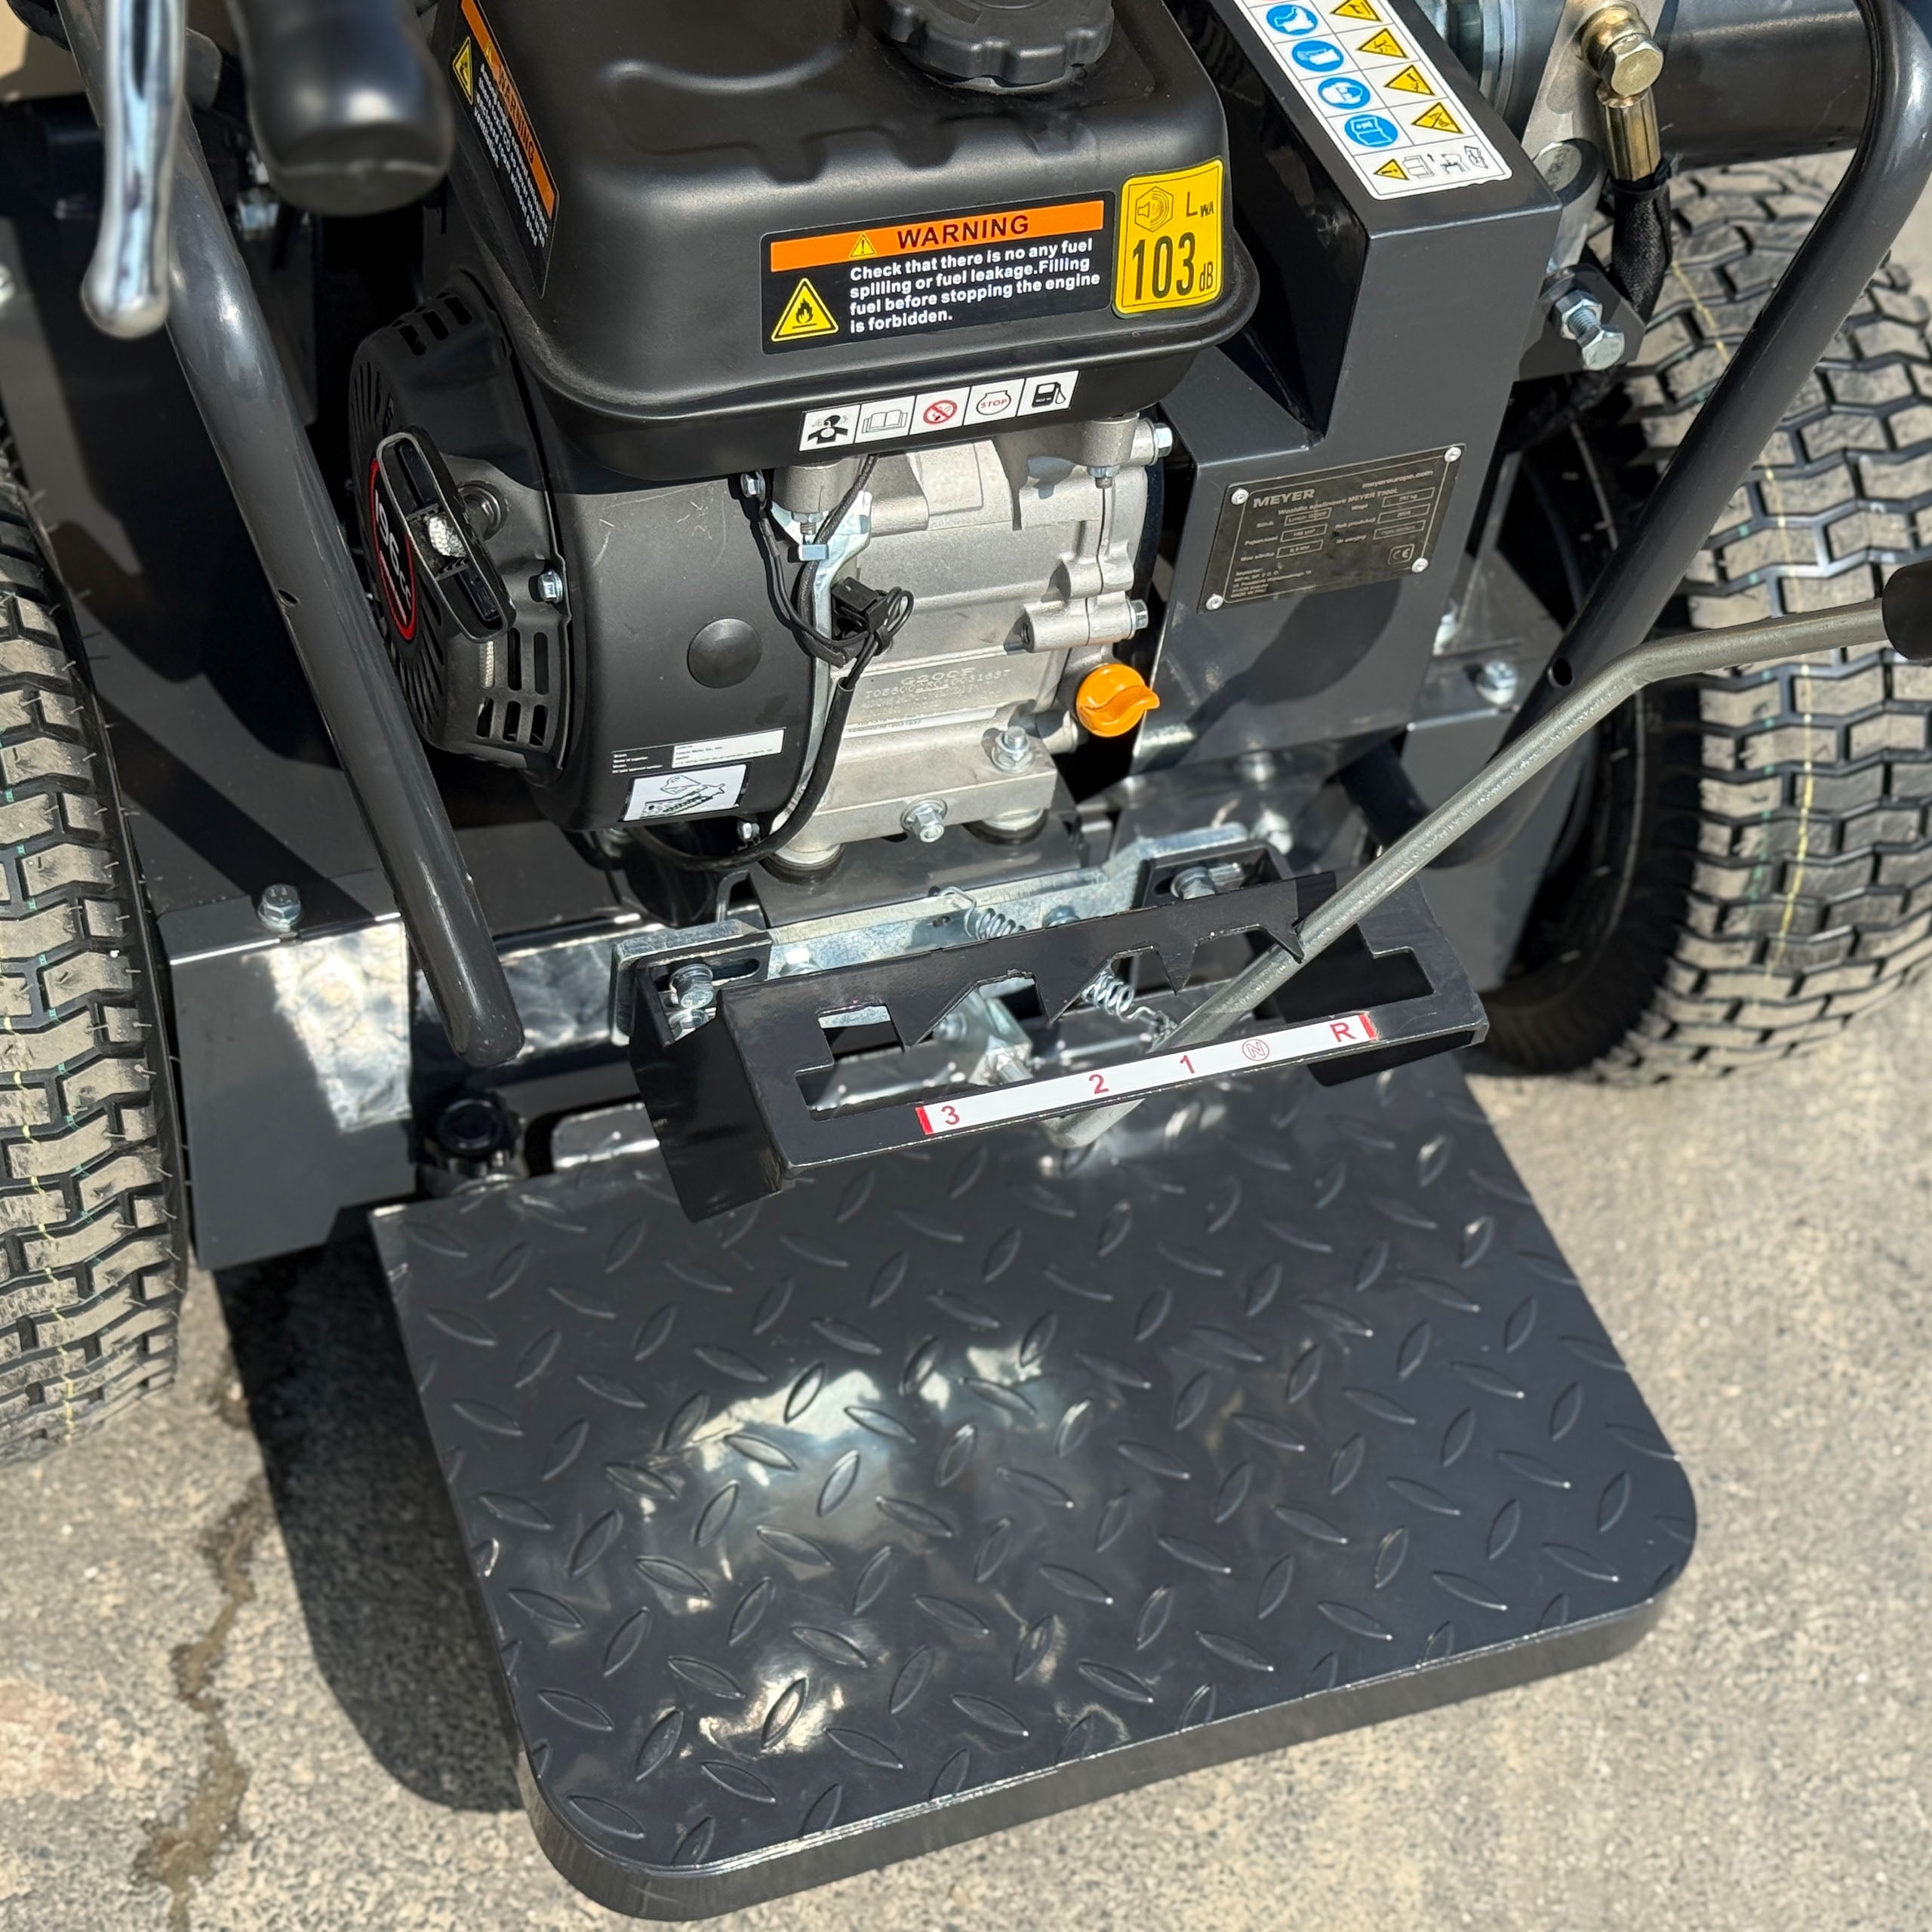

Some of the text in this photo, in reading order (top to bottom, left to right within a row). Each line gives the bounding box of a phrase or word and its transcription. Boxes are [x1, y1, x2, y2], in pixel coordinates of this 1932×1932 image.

[498, 63, 535, 164] WARNING
[897, 215, 1029, 249] WARNING
[850, 237, 1093, 281] Check that there is no any fuel
[1133, 232, 1214, 300] 103 dB
[850, 279, 912, 300] spilling
[915, 277, 934, 290] or
[936, 270, 968, 287] fuel
[850, 273, 1101, 315] fuel before stopping the engine
[850, 309, 953, 334] is forbidden.
[981, 398, 1008, 408] STOP
[1253, 488, 1315, 508] MEYER
[941, 1023, 1356, 1126] 3 2 1 N R
